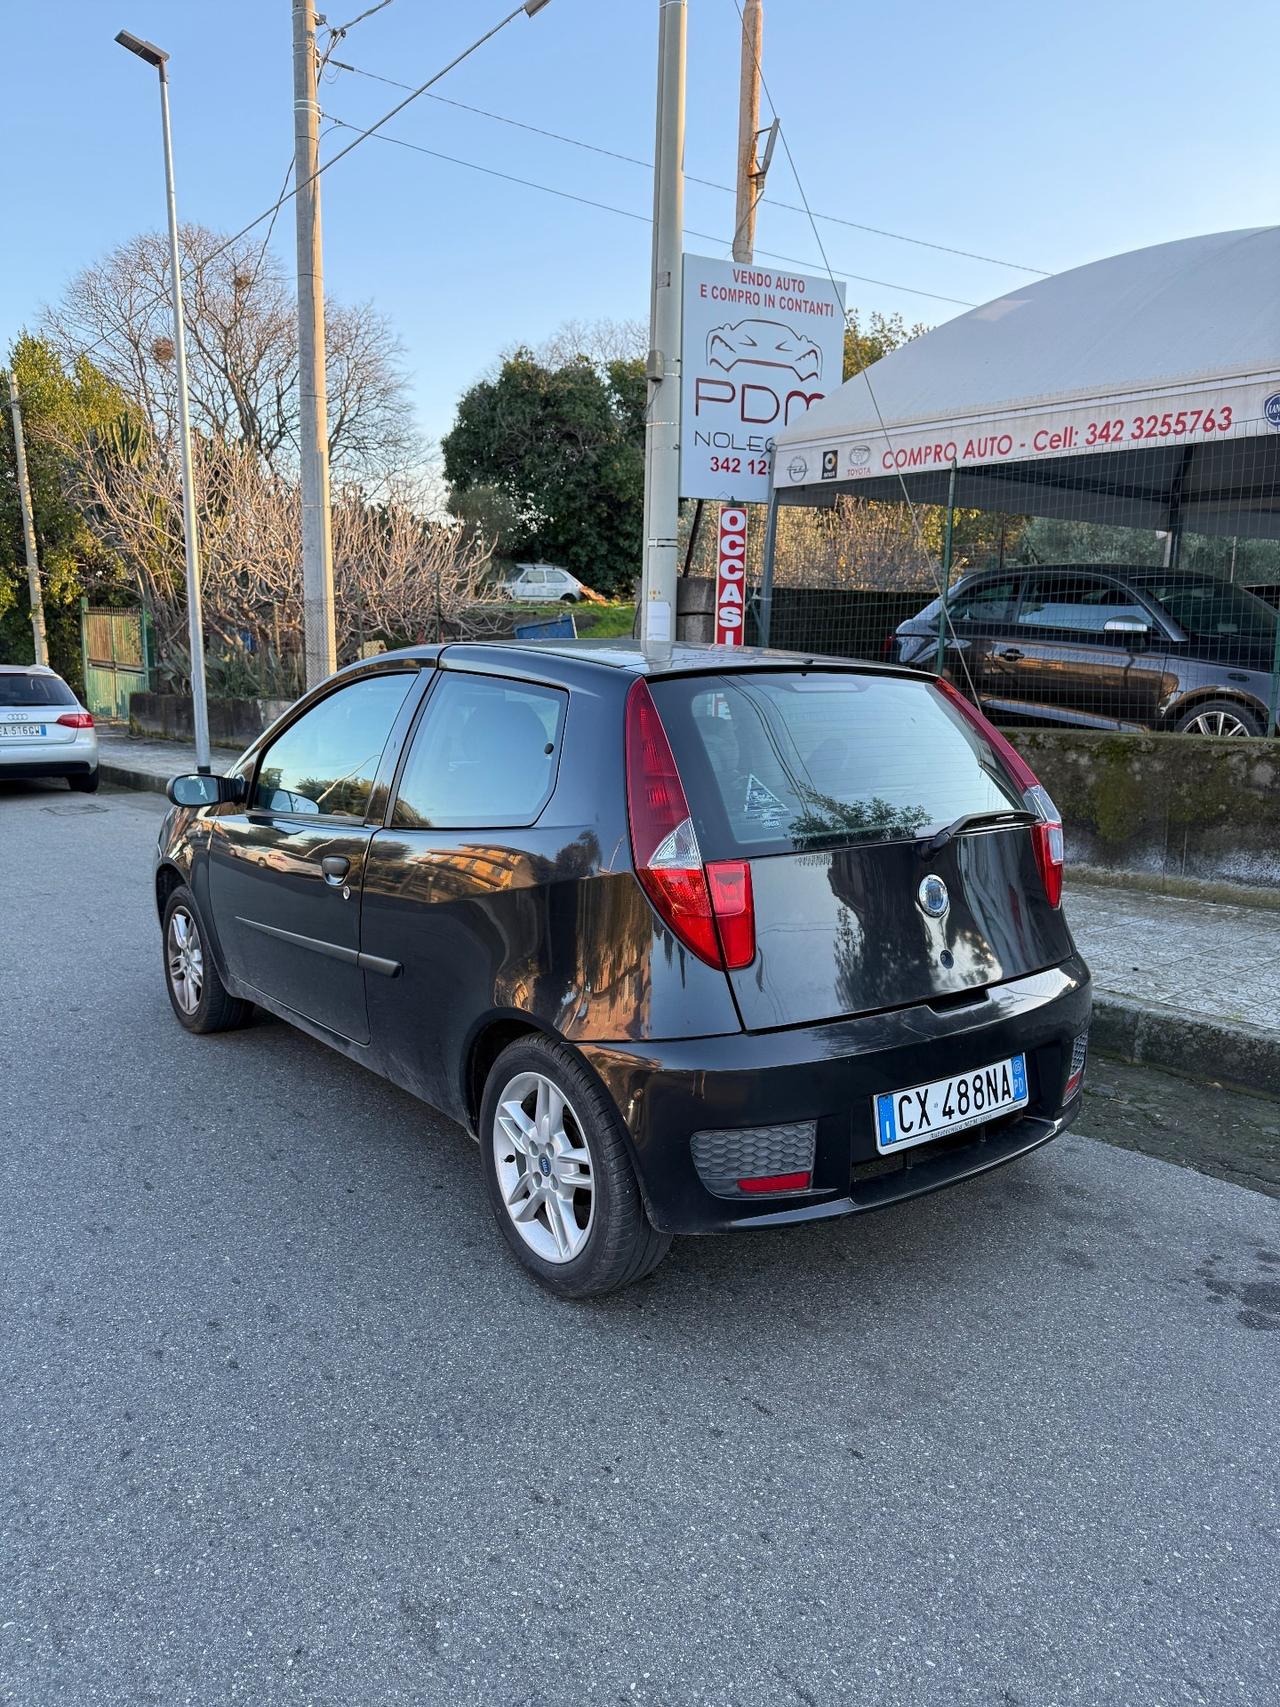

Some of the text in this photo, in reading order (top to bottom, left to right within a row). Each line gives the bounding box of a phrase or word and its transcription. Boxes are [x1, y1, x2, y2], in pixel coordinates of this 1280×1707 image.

[733, 269, 805, 294] VENDO AUTO
[700, 284, 834, 317] E COMPRO IN CONTANTI
[882, 442, 957, 469] COMPRO
[963, 435, 1012, 460] AUTO
[1034, 426, 1079, 451] Cell:
[1085, 419, 1125, 445] 342
[1130, 406, 1233, 440] 3255763
[710, 456, 771, 475] 342 12
[847, 467, 871, 477] TOYOTA
[898, 1088, 931, 1133] CX
[942, 1064, 1012, 1120] 488NA
